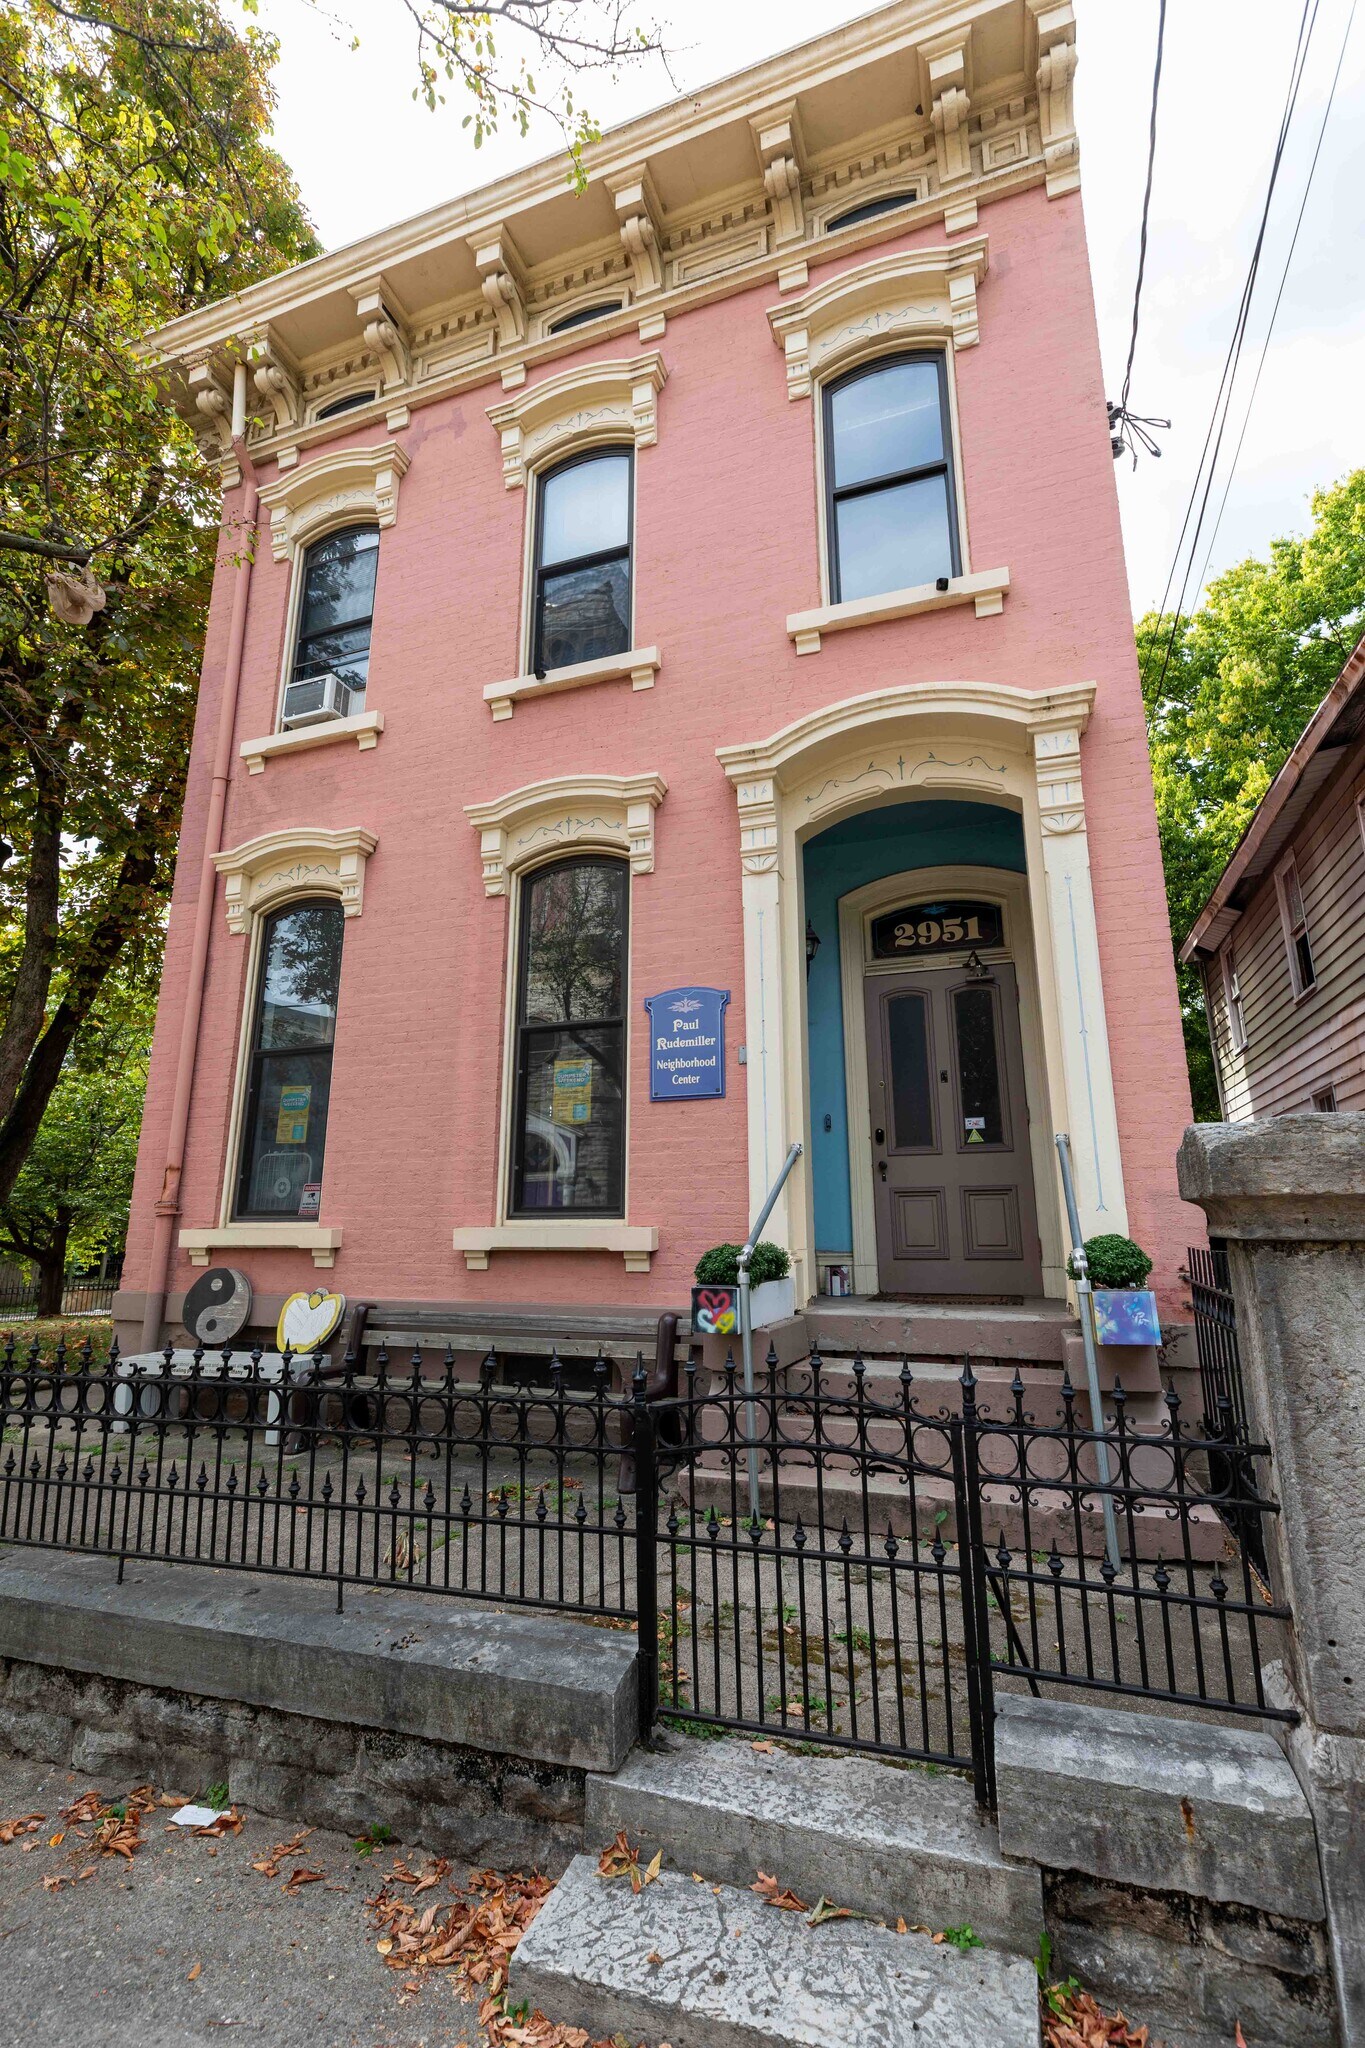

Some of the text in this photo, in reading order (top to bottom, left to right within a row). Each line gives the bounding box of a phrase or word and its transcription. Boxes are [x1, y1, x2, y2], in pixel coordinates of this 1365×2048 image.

[894, 916, 983, 947] 2951
[673, 1019, 699, 1032] Paul
[656, 1036, 716, 1051] Rudemiller
[656, 1056, 716, 1071] Neighborhood
[672, 1074, 700, 1085] Center
